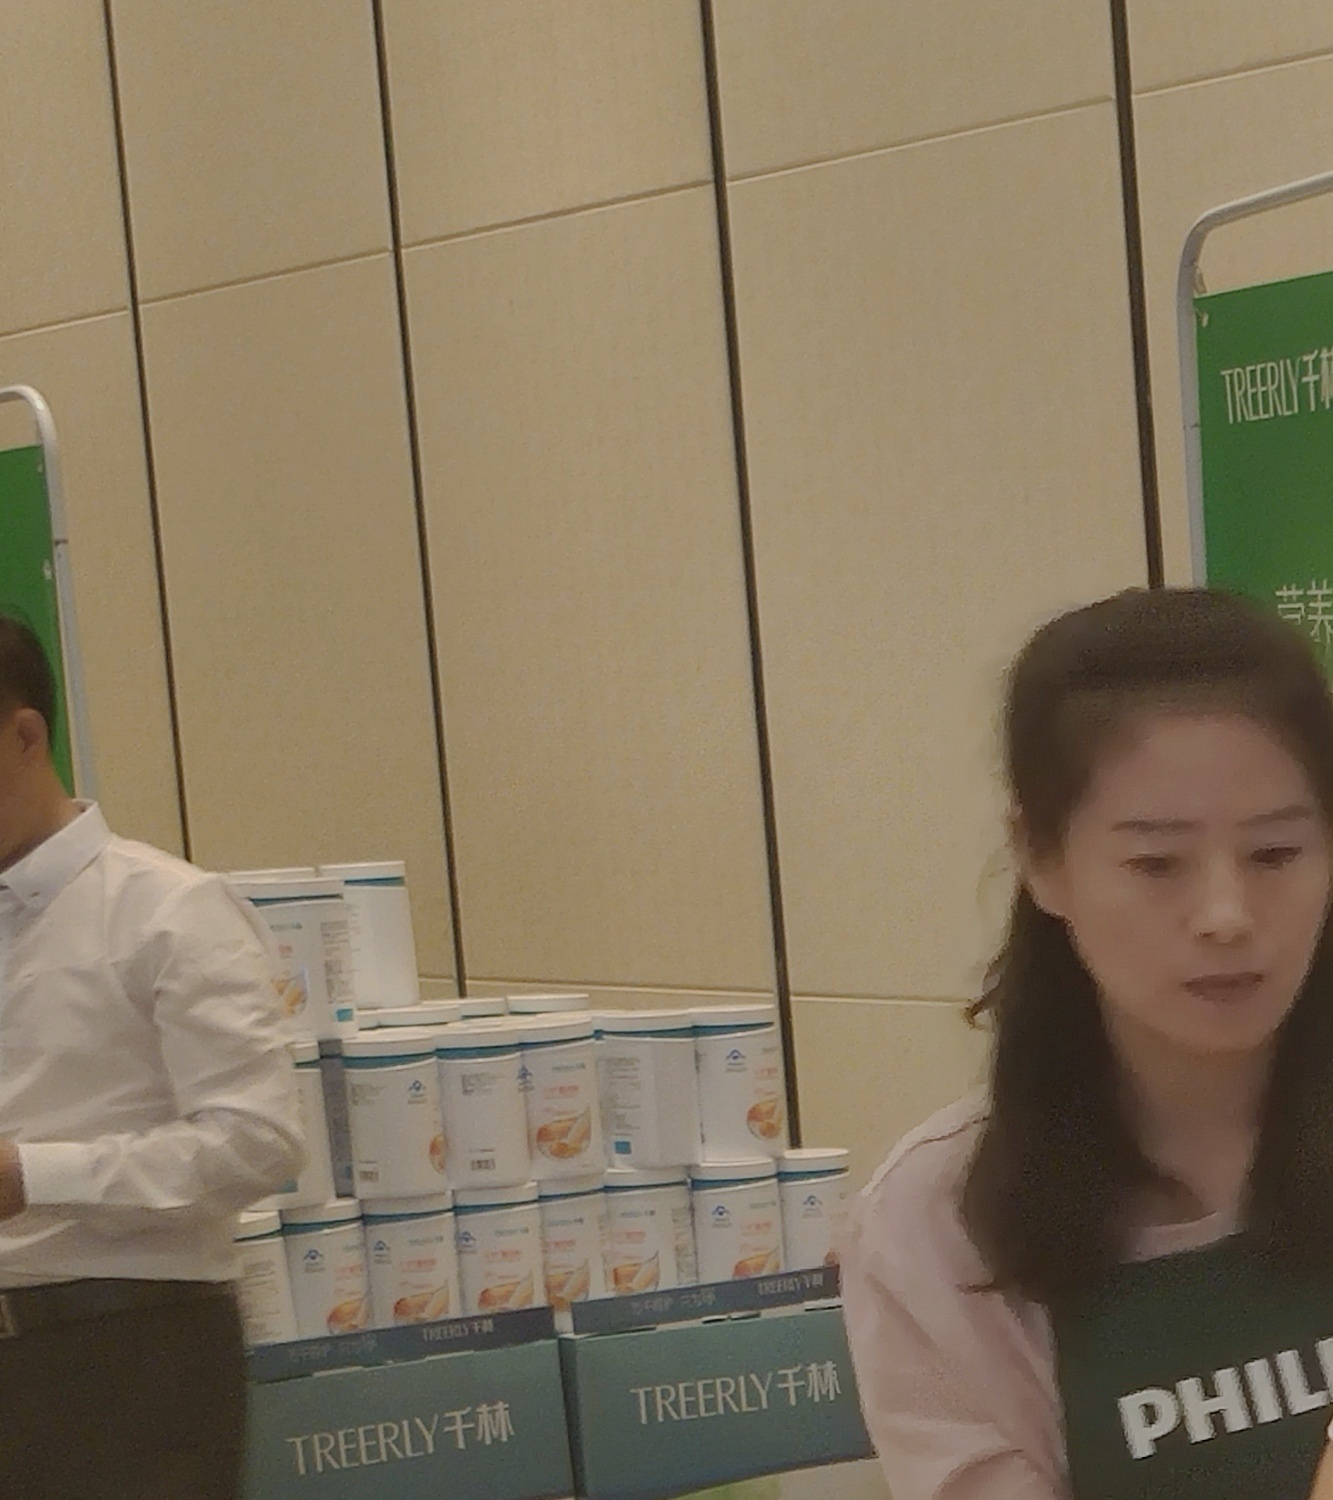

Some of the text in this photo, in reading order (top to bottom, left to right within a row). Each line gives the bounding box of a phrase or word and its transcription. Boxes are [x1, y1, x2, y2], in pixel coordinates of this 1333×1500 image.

[1220, 359, 1300, 424] TREERLY
[629, 1360, 841, 1425] TREERLY 千林
[285, 1400, 515, 1475] TREERLY 千林
